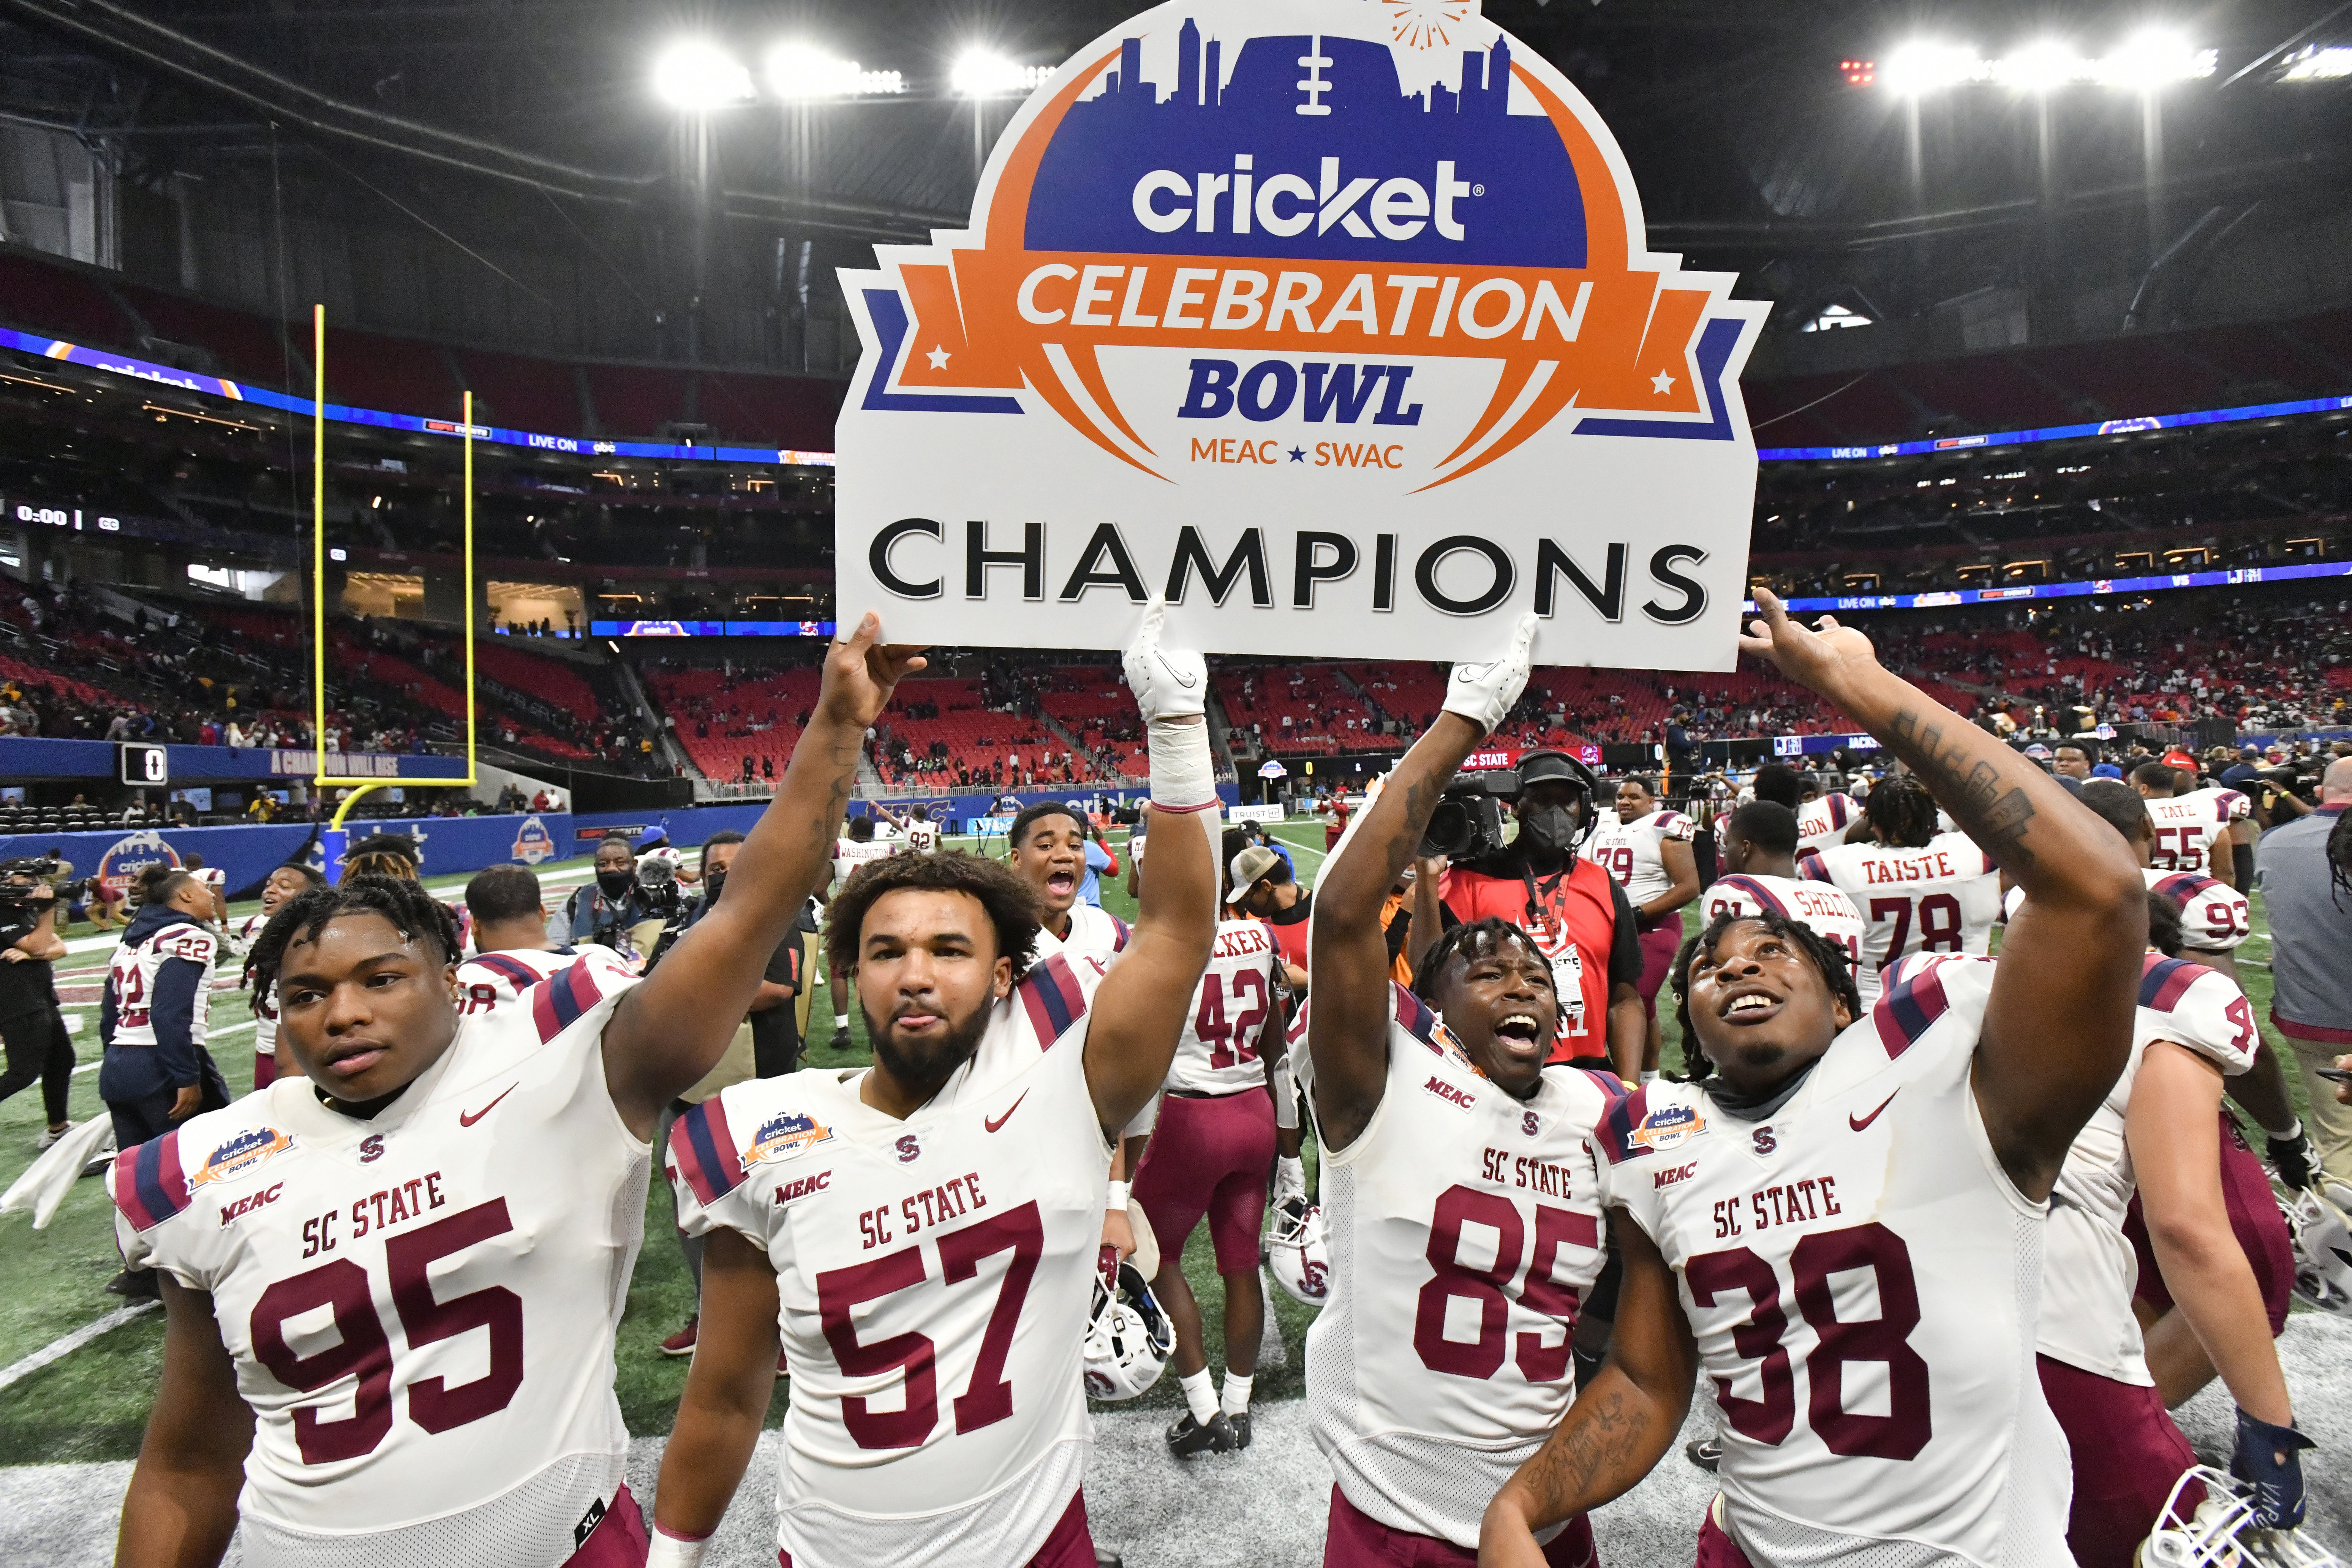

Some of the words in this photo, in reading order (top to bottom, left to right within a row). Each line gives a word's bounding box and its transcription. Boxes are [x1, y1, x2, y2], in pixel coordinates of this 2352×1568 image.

[1132, 153, 1470, 241] cricket
[1016, 264, 1595, 342] CELEBRATION
[1178, 359, 1424, 427] BOWL
[529, 435, 555, 449] LIVE
[557, 437, 577, 451] ON
[593, 441, 616, 454] abc
[1191, 438, 1279, 466] MEAC
[1314, 443, 1404, 469] SWAC
[1832, 448, 1851, 458] LIVE
[1852, 448, 1867, 458] ON
[17, 506, 67, 526] 0:00
[868, 518, 1709, 624] CHAMPIONS
[2172, 575, 2189, 586] VS
[1838, 599, 1859, 609] LIVE
[1859, 598, 1875, 608] ON
[145, 750, 163, 781] 0
[271, 751, 281, 774] A
[348, 755, 374, 775] WILL
[375, 756, 398, 777] RISE
[1306, 762, 1313, 775] 0
[1464, 754, 1476, 766] SC
[1481, 753, 1508, 765] STATE
[1065, 792, 1150, 817] cricke
[2158, 805, 2196, 818] TATE
[910, 831, 930, 849] 92
[1677, 820, 1693, 839] 79
[1799, 817, 1827, 838] SON
[841, 846, 888, 858] WASHINGTON
[1134, 842, 1146, 851] MA
[2152, 827, 2202, 871] 55
[1597, 848, 1633, 887] 79
[1862, 853, 1955, 884] TAISTE
[1794, 891, 1862, 920] SHELTON
[2206, 900, 2250, 939] 93
[1215, 929, 1268, 958] LKER
[1870, 894, 1963, 972] 78
[176, 938, 211, 959] 22
[1195, 969, 1269, 1070] 42
[2225, 996, 2259, 1054] 4
[1452, 1050, 1469, 1067] BOWL
[1424, 1076, 1476, 1108] MEAC
[765, 1123, 801, 1139] cricket
[1644, 1121, 1696, 1136] CELEBRATION
[1655, 1115, 1686, 1127] cricket
[221, 1138, 262, 1160] cricket
[755, 1129, 816, 1153] CELEBRATION
[773, 1141, 800, 1154] BOWL
[1659, 1132, 1681, 1141] BOWL
[207, 1141, 277, 1174] CELEBRATION
[228, 1157, 258, 1174] BOWL
[776, 1170, 832, 1205] MEAC
[1482, 1147, 1508, 1183] SC
[1516, 1157, 1571, 1200] STATE
[1654, 1161, 1698, 1189] MEAC
[221, 1181, 284, 1226] MEAC
[303, 1210, 338, 1259] SC
[353, 1171, 446, 1238] STATE
[860, 1205, 892, 1249] SC
[902, 1172, 986, 1234] STATE
[1713, 1198, 1741, 1238] SC
[1753, 1176, 1841, 1230] STATE
[1414, 1184, 1598, 1383] 85
[250, 1196, 523, 1465] 95
[816, 1199, 1044, 1449] 57
[1685, 1221, 1932, 1461] 38
[582, 1510, 601, 1533] XL
